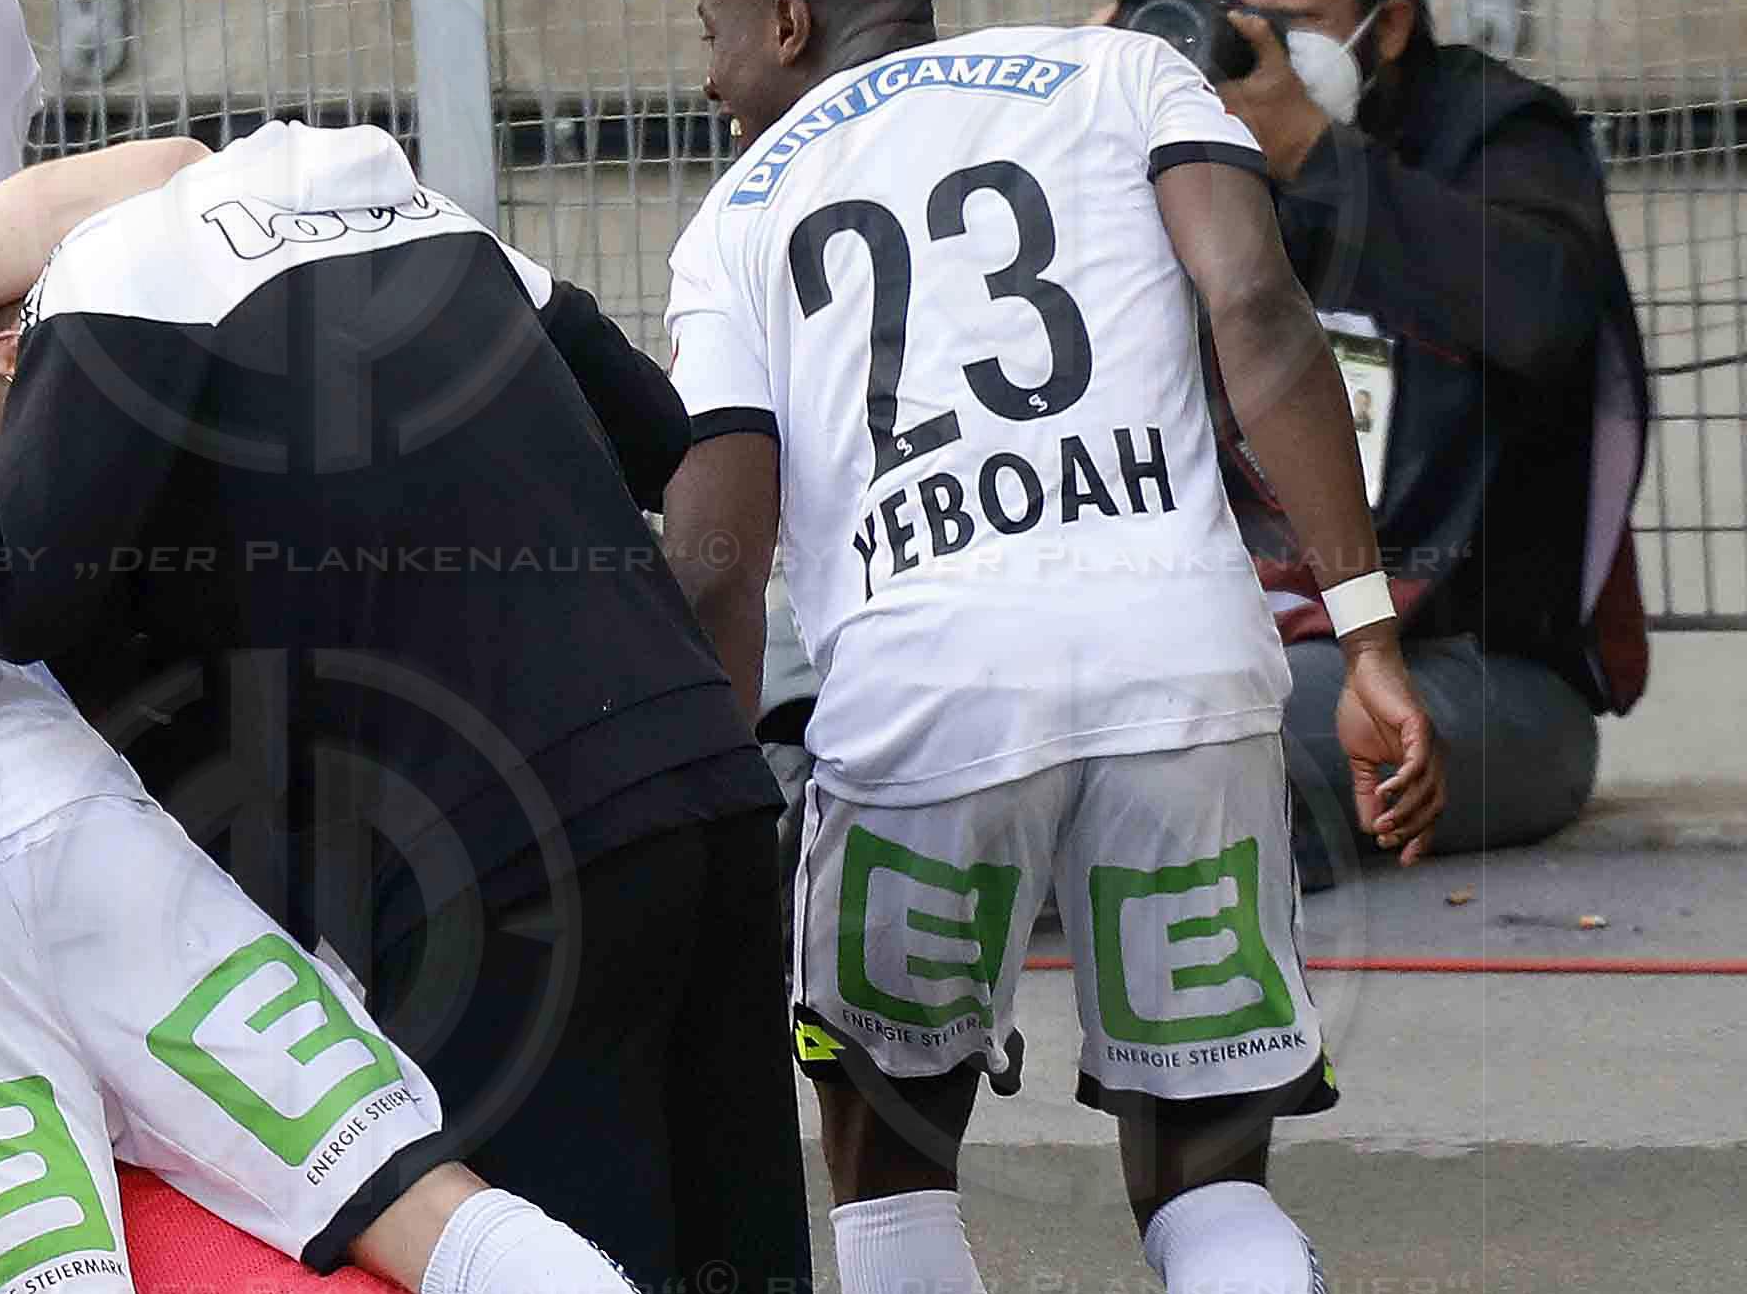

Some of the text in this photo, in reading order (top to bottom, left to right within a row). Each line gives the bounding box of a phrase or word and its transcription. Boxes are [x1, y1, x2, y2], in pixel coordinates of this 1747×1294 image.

[744, 58, 1063, 198] PUNTIGAMER
[789, 160, 1092, 490] 23
[853, 427, 1179, 602] YEBOAH
[1188, 1032, 1307, 1065] STEIERMARK
[306, 1115, 364, 1187] ENERGIE
